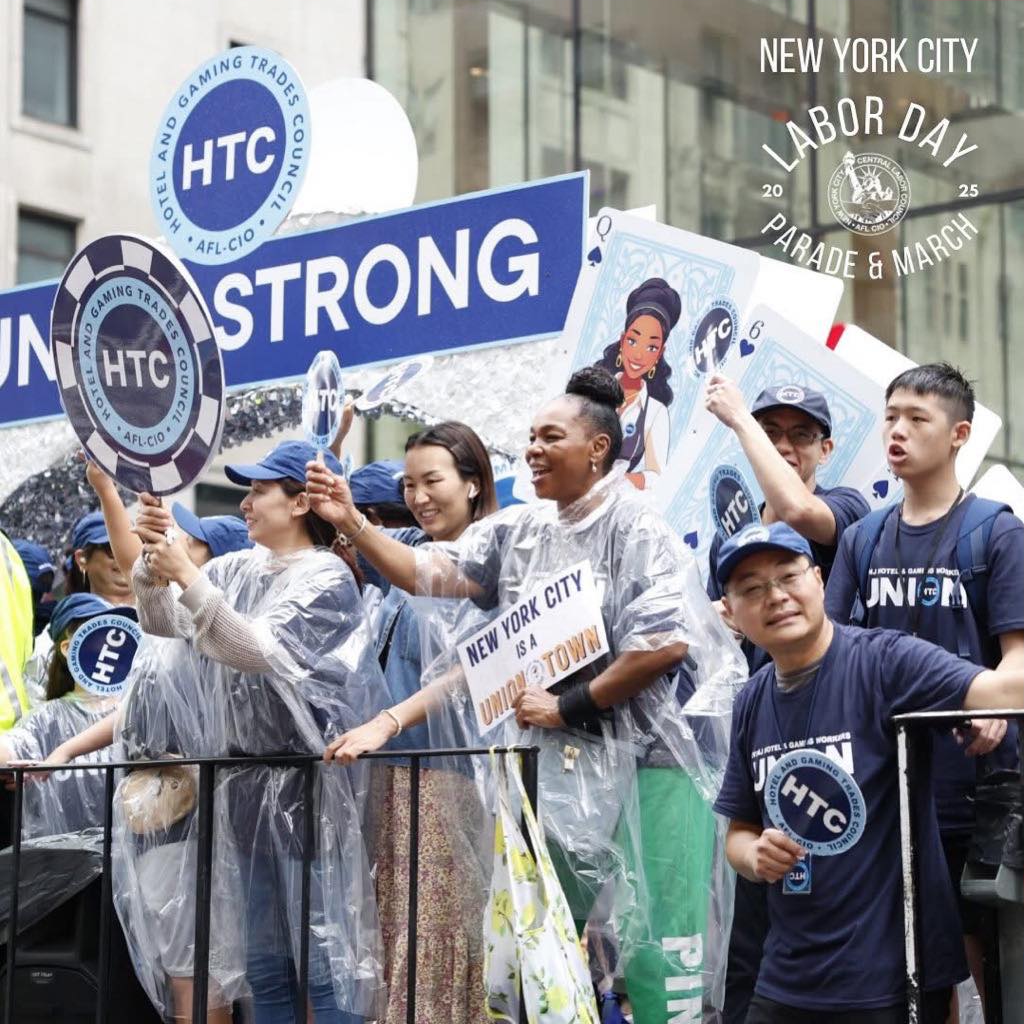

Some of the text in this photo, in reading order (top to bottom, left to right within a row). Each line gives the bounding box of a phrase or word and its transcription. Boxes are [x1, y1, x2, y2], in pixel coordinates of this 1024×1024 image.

[156, 55, 305, 235] HOTEL AND GAMING TRADES COUNCIL
[182, 126, 276, 191] HTC
[195, 228, 255, 256] AFL-CIO
[596, 215, 612, 242] Q
[213, 217, 540, 353] STRONG
[83, 285, 190, 425] HOTEL AND GAMING TRADES COUNCIL
[749, 320, 765, 340] 6
[103, 349, 170, 389] HTC
[124, 432, 165, 447] AFL-CIO
[720, 490, 749, 538] HTC
[466, 569, 582, 667] NEW YORK CITY
[515, 633, 538, 659] IS A
[70, 618, 142, 693] HOTEL AND GAMING TRADES COUNCIL
[91, 628, 127, 684] HTC
[479, 625, 602, 726] UNION TOWN
[815, 731, 852, 745] WORKERS
[769, 756, 861, 851] HOTEL AND GAMING TRADES COUNCIL
[780, 775, 848, 834] HTC
